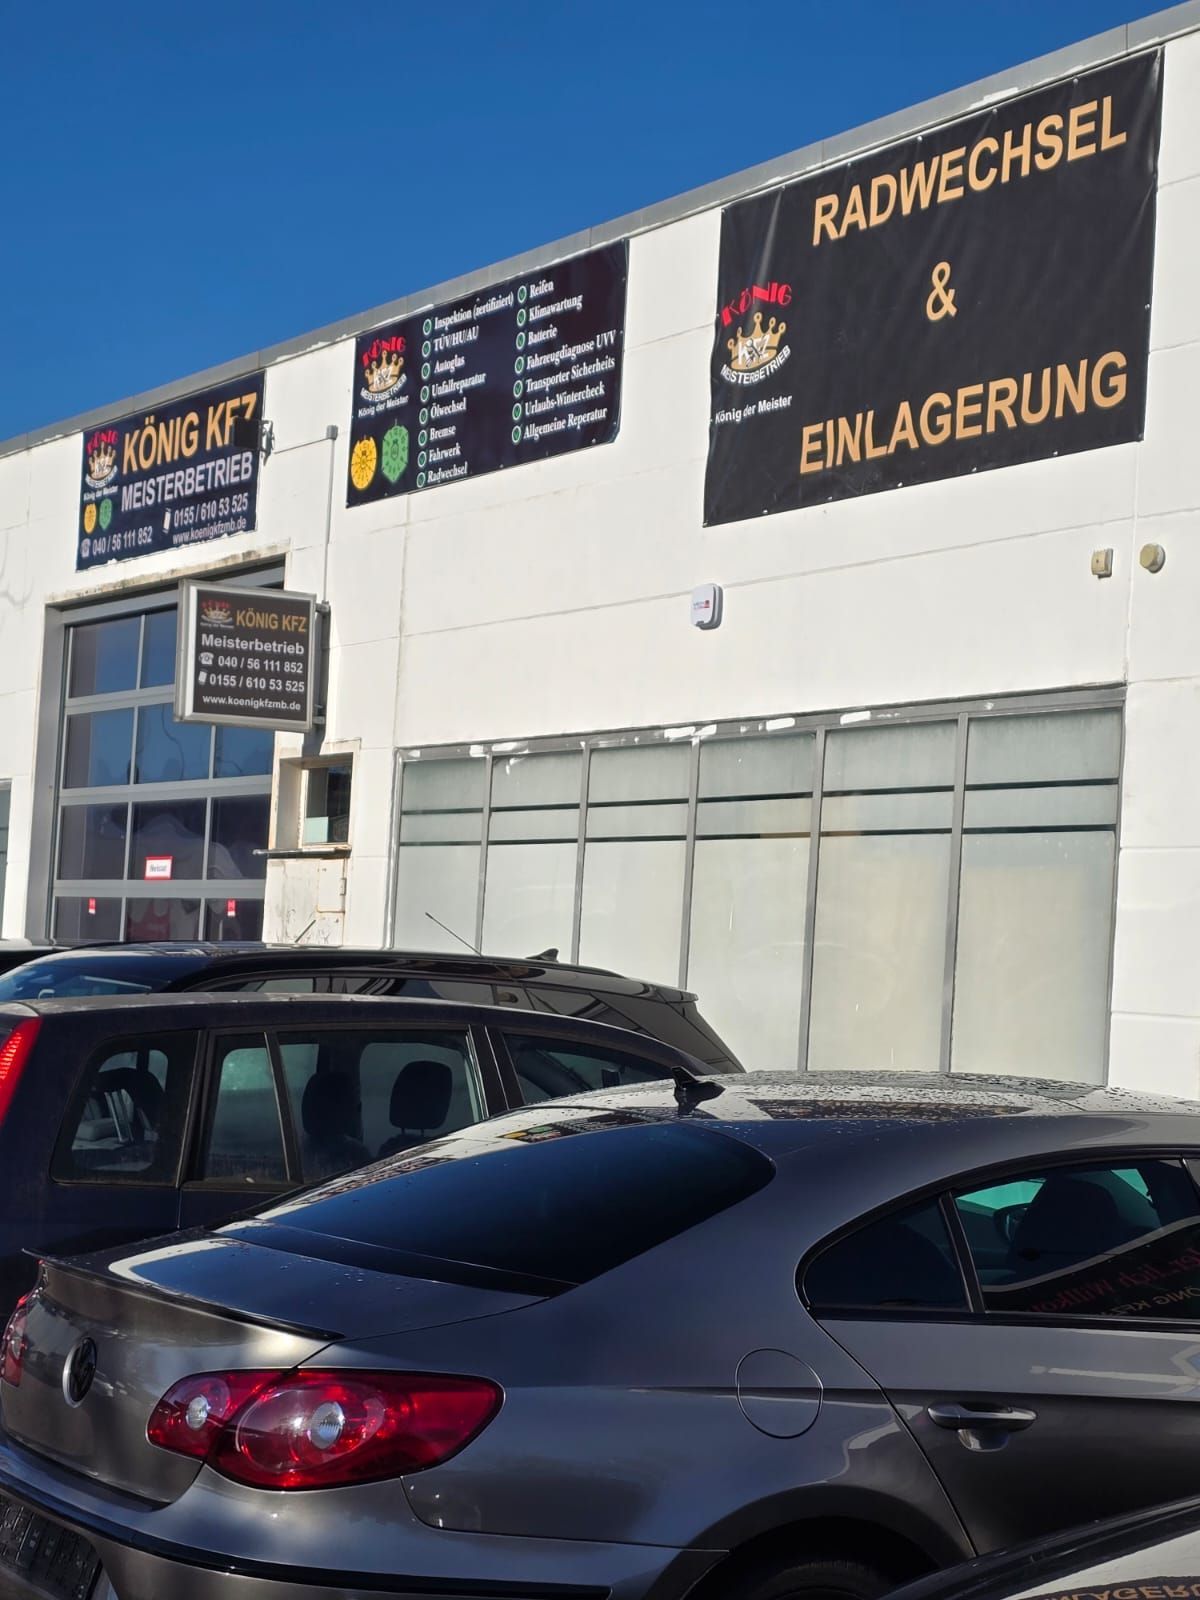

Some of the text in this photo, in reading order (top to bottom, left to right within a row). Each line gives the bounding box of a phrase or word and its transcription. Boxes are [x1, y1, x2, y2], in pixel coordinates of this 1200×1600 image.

[813, 95, 1127, 246] RADWECHSEL
[529, 279, 554, 298] Reifen
[926, 261, 958, 321] &
[434, 308, 472, 331] Inspektion
[529, 294, 583, 322] Klimawartung
[528, 324, 557, 345] Batterie
[526, 329, 616, 370] Fahrzeugdiagnose UVV
[434, 354, 465, 373] Autoglas
[526, 355, 615, 392] Transporter Sicherheits
[720, 344, 791, 384] MEISTERBETRIEB
[431, 373, 486, 397] Unfallreparatur
[430, 396, 467, 418] Ölwechsel
[525, 381, 605, 416] Urlaubs-Wintercheck
[715, 395, 793, 425] König der Meister
[800, 351, 1127, 474] EINLAGERUNG
[430, 425, 456, 441] Bremse
[523, 416, 566, 440] Allgemeine
[122, 412, 199, 475] KÖNIG
[428, 442, 461, 462] Fahrwerk
[121, 451, 253, 512] MEISTERBETRIEB
[427, 461, 468, 483] Radwechsel
[174, 506, 194, 528] 0155
[201, 501, 216, 520] 610
[219, 497, 230, 516] 53
[231, 493, 249, 513] 525
[92, 537, 107, 556] 040
[112, 533, 121, 551] 56
[123, 529, 136, 548] 111
[138, 526, 153, 545] 852
[172, 516, 247, 544] www.koenigkfzmb.de
[236, 608, 278, 629] KÖNIG
[282, 614, 307, 632] KFZ
[201, 633, 304, 655] Meisterbetrieb
[218, 655, 238, 668] 040
[247, 658, 260, 670] 56
[263, 659, 280, 672] 111
[284, 661, 303, 674] 852
[209, 673, 237, 687] 0155
[245, 677, 266, 689] 610
[269, 678, 282, 691] 53
[285, 680, 305, 692] 525
[202, 695, 301, 711] www.koenigkfzmb.de
